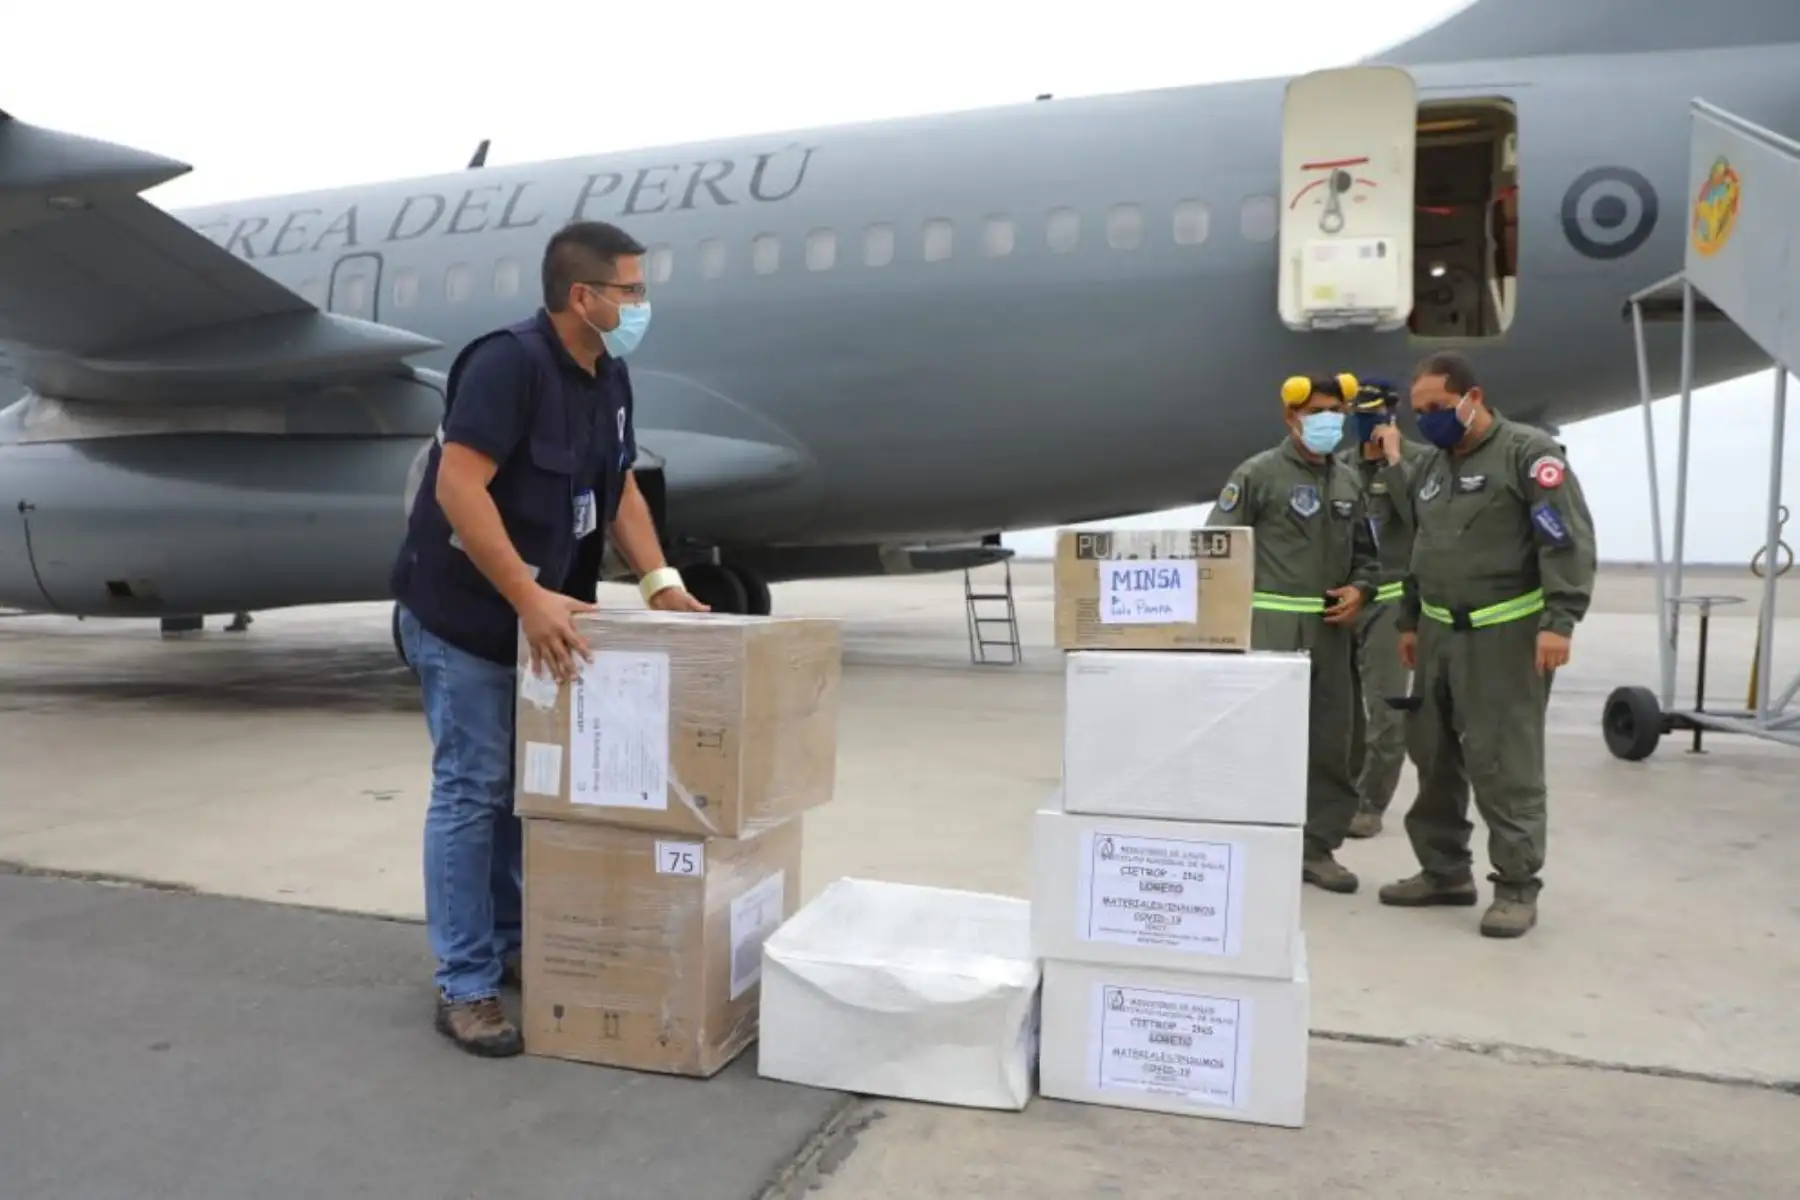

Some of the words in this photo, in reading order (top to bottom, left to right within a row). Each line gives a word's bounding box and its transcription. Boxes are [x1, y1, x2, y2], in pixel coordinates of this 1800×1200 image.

[383, 179, 545, 243] DEL
[1111, 567, 1181, 592] MINSA
[668, 851, 694, 873] 75
[1139, 880, 1184, 893] LORETO
